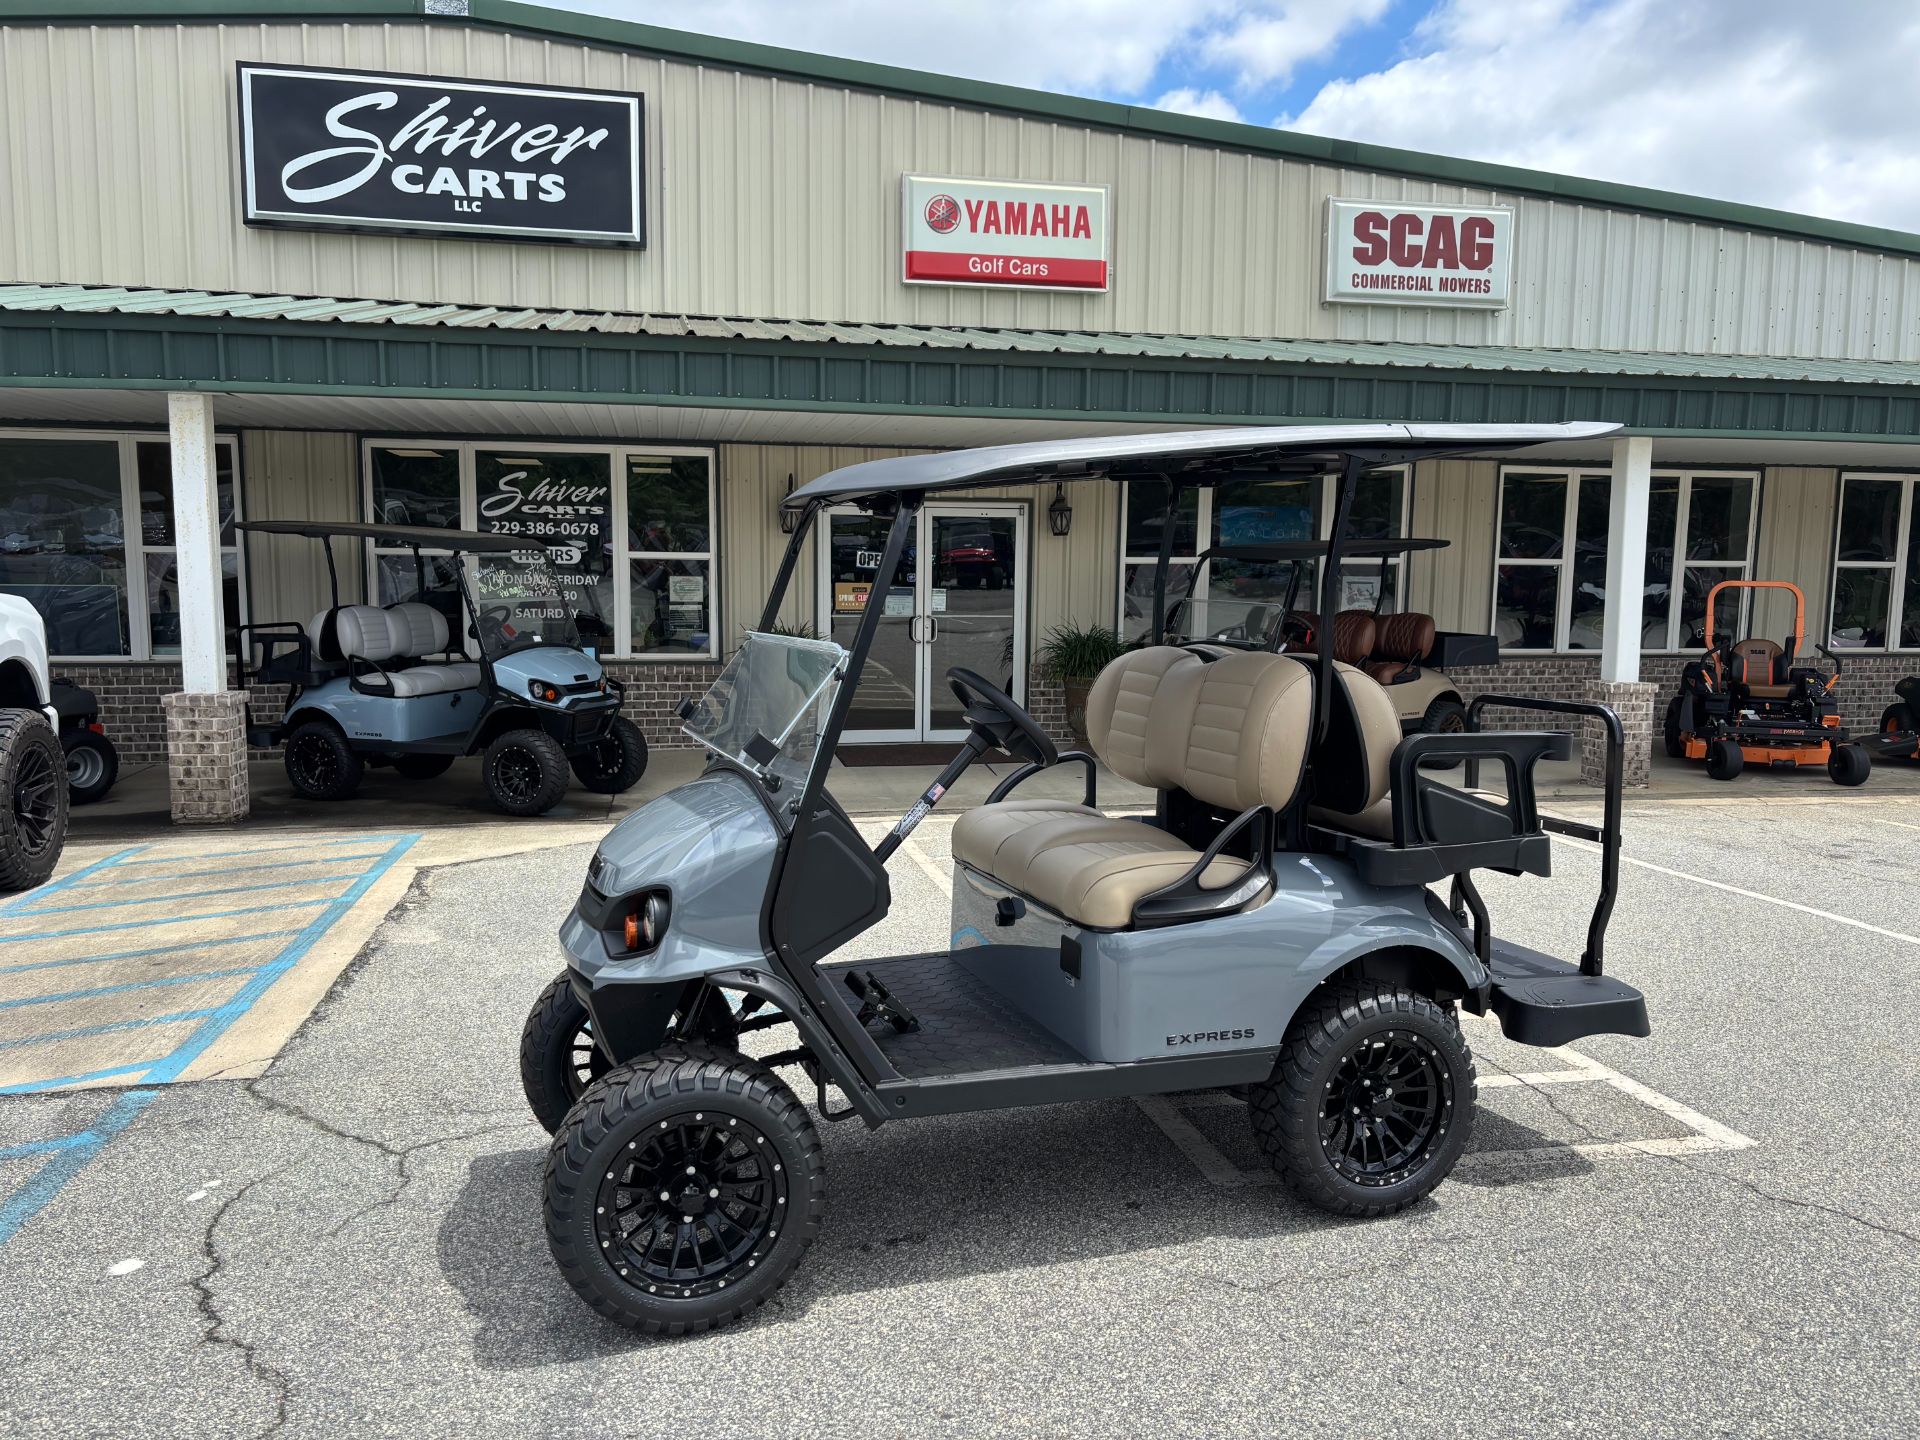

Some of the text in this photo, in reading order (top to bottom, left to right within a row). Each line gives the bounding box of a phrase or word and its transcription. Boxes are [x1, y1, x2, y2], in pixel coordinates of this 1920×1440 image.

[281, 91, 609, 203] Shiver
[391, 164, 566, 203] CARTS
[454, 199, 482, 213] LLC
[964, 199, 1092, 239] YAMAHA
[1352, 211, 1495, 271] SCAG
[968, 256, 1049, 276] Golf Cars
[1352, 273, 1491, 294] COMMERCIAL MOWERS
[481, 471, 607, 517] Shiver
[521, 505, 604, 515] CARTS
[491, 521, 599, 536] 229-386-0678
[859, 553, 881, 567] OPE
[557, 575, 599, 586] FRIDAY
[515, 608, 579, 619] SATURDY
[1166, 1028, 1255, 1046] EXPRESS
